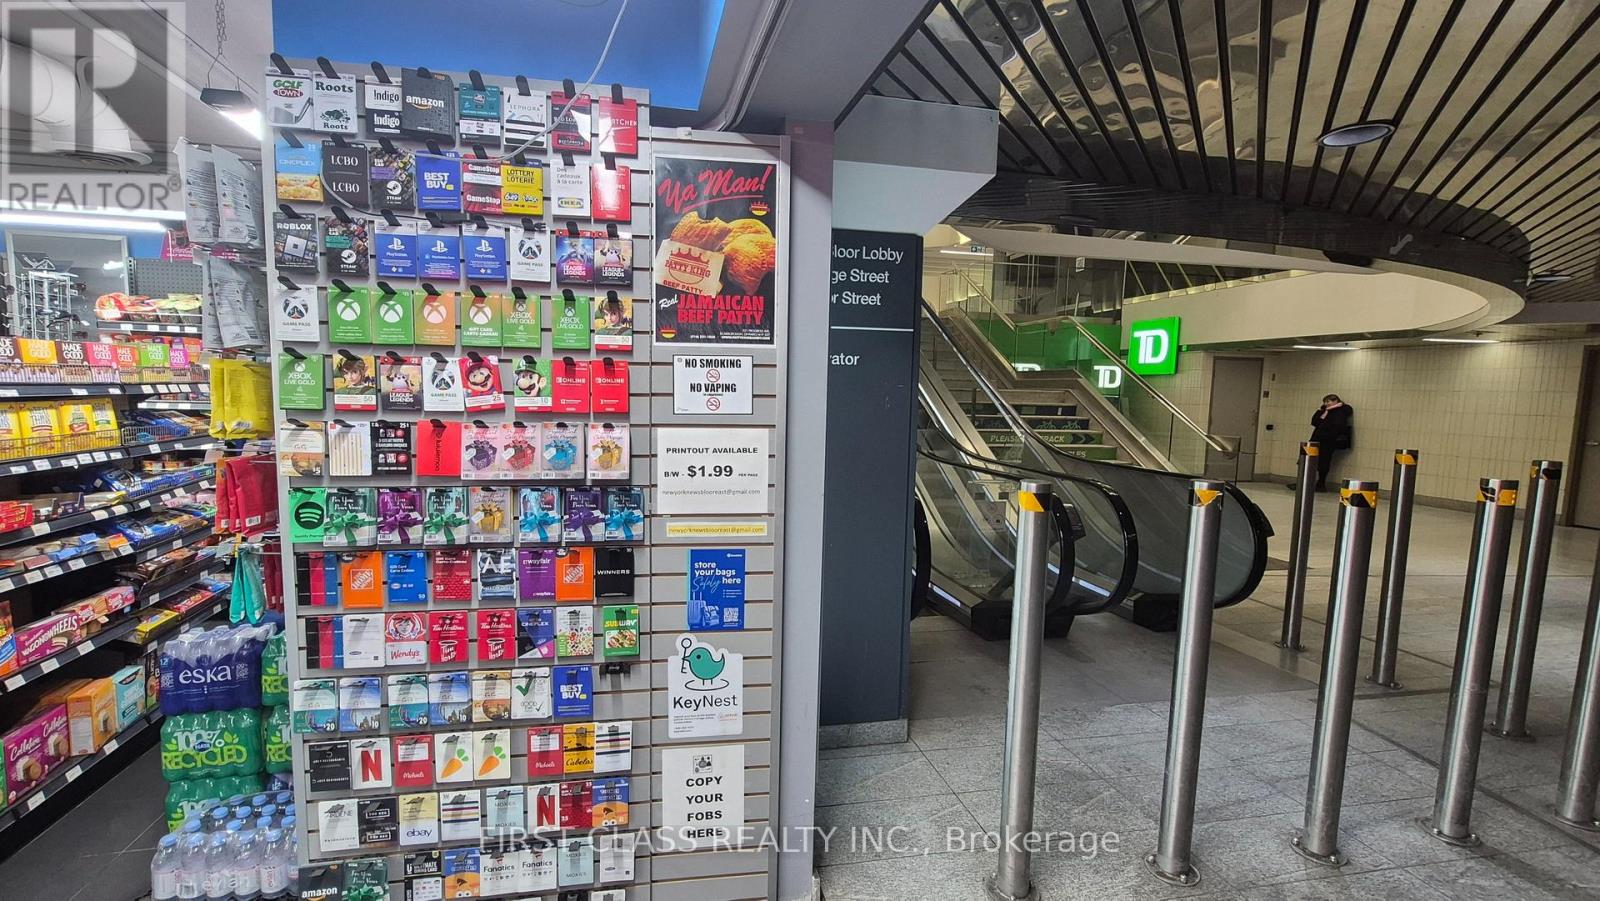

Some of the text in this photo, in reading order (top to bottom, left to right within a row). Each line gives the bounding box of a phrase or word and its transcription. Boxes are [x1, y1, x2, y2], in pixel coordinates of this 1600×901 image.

[273, 80, 303, 89] GOLF
[315, 81, 353, 93] Roots
[406, 95, 444, 108] amazon
[323, 122, 348, 130] Roots
[331, 155, 358, 166] LCBO
[468, 163, 500, 173] GameStop
[424, 172, 449, 181] BEST
[507, 176, 535, 184] LOTERIE
[698, 165, 774, 196] Man!
[332, 182, 360, 193] LCBO
[426, 181, 447, 189] BUY
[466, 194, 500, 205] GameStop
[277, 222, 312, 231] ROBLOX
[863, 246, 904, 264] Lobby
[850, 268, 890, 283] Street
[659, 294, 765, 311] Real JAMAICAN
[842, 291, 881, 305] Street
[677, 310, 764, 325] BEEF PATTY
[62, 343, 82, 351] MADE
[1133, 329, 1169, 364] TD
[63, 351, 84, 359] GOOD
[94, 351, 112, 360] GOOD
[118, 354, 133, 362] GOOD
[149, 351, 164, 360] GOOD
[830, 352, 860, 365] ator
[684, 359, 742, 369] NO SMOKING
[1094, 365, 1122, 388] TD
[690, 383, 737, 393] NO VAPING
[687, 465, 733, 479] $1.99
[527, 558, 551, 566] wayfair
[695, 569, 715, 577] your
[693, 577, 721, 593] Safely
[46, 615, 78, 640] WHEELS
[604, 619, 637, 628] SUBWAY
[391, 649, 420, 660] Wendy's
[179, 665, 232, 684] eska
[673, 695, 738, 711] KeyNest
[174, 729, 225, 752] 100%
[161, 746, 247, 770] RECYCLED
[361, 750, 383, 782] N
[686, 776, 723, 787] COPY
[686, 793, 723, 805] YOUR
[537, 795, 556, 826] N
[687, 811, 722, 821] FOBS
[407, 828, 433, 838] ebay
[687, 828, 723, 838] HERE
[483, 865, 515, 873] Fanatics
[302, 887, 337, 898] amazon
